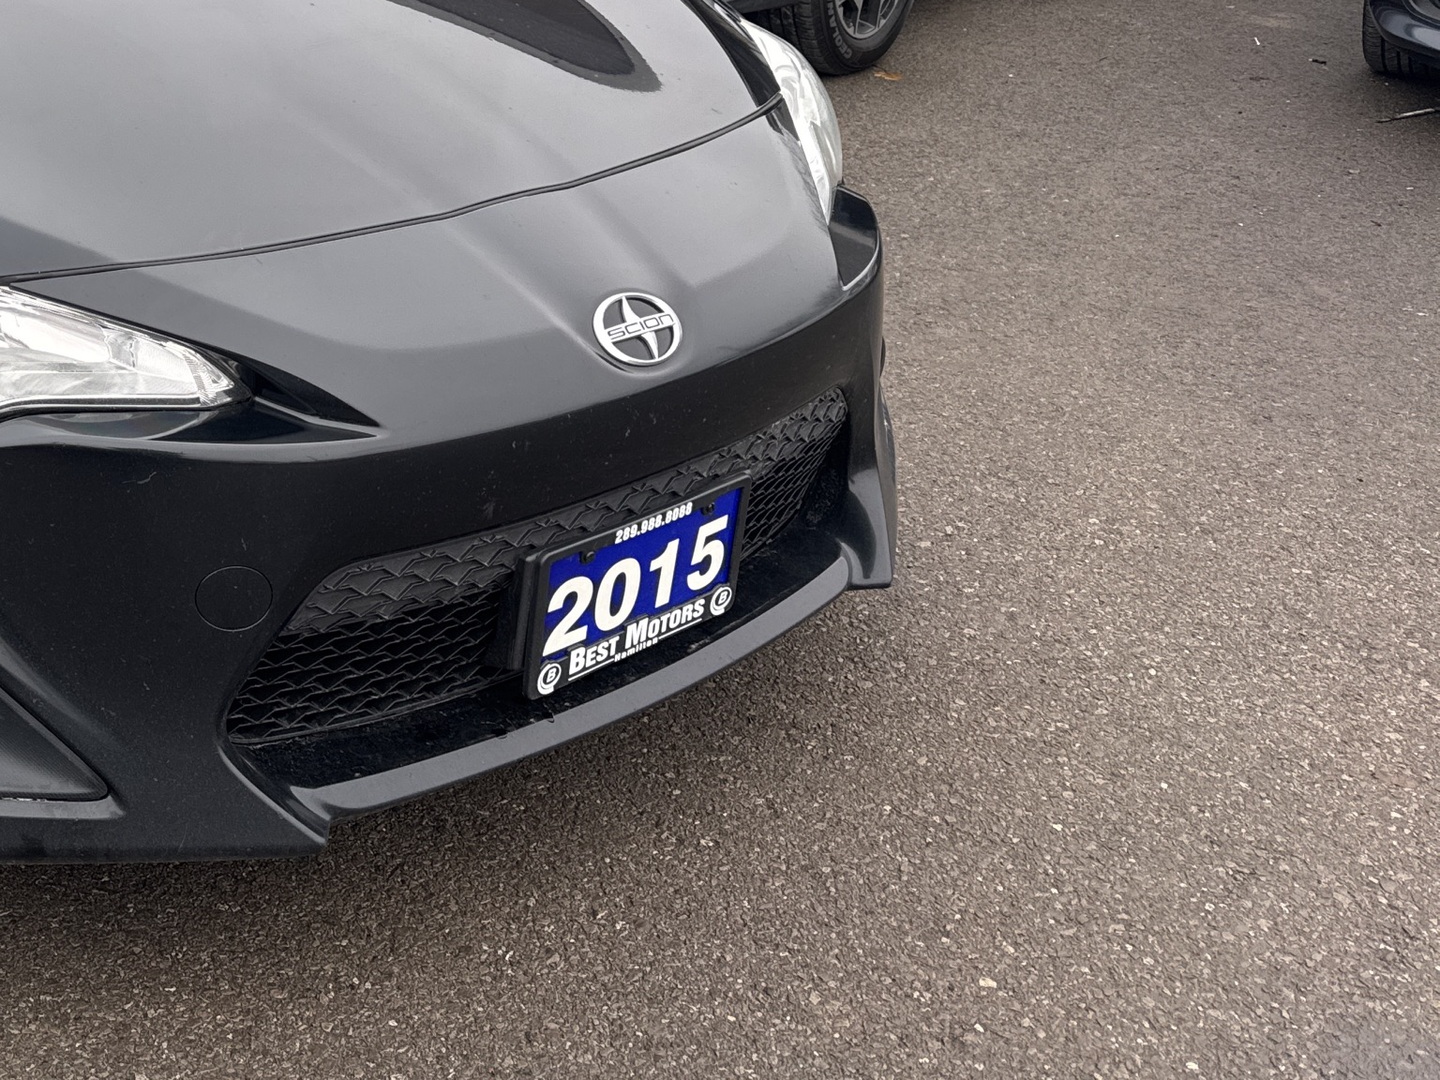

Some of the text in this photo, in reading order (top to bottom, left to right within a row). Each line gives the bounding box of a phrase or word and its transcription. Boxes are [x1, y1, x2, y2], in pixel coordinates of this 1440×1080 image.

[614, 502, 693, 545] 289.988.8088
[542, 514, 729, 657] 2015
[569, 598, 706, 675] BEST MOTORS
[614, 636, 659, 662] Hamilton
